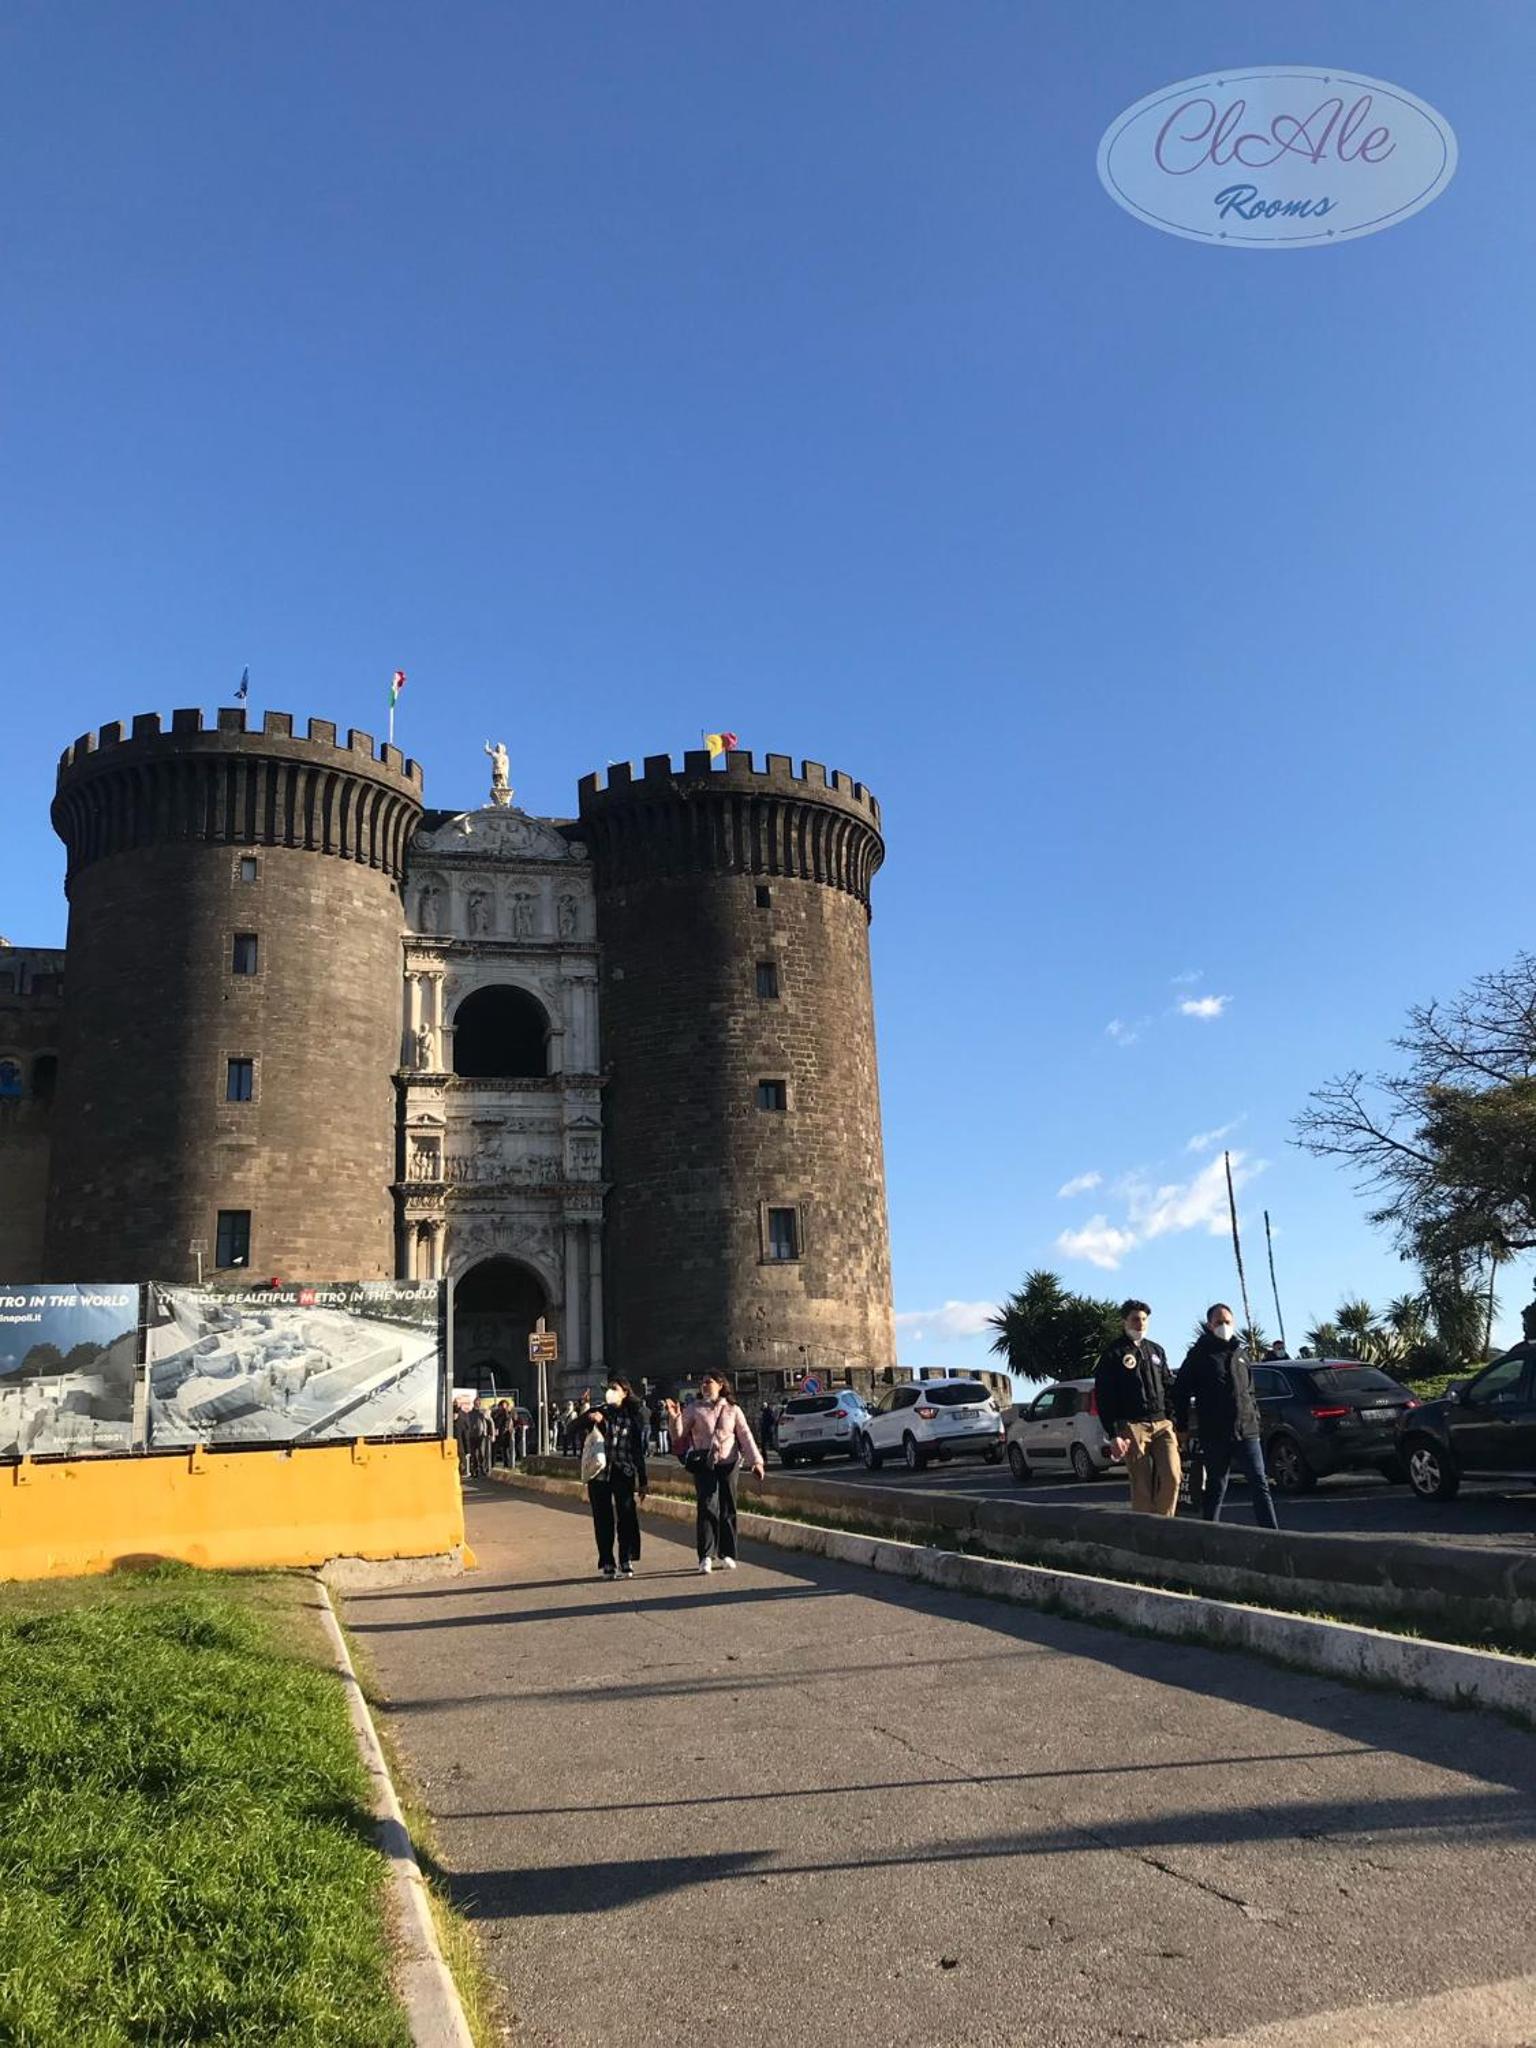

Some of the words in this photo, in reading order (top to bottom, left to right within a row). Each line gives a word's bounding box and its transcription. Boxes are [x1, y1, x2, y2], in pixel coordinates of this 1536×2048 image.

[28, 1296, 46, 1308] IN
[49, 1295, 77, 1308] THE
[80, 1294, 130, 1308] WORLD
[157, 1293, 182, 1304] TH
[227, 1292, 298, 1304] BEAUTIFUL
[299, 1291, 347, 1304] METRO
[349, 1291, 364, 1302] IN
[367, 1290, 394, 1301] THE
[394, 1288, 438, 1300] WORLD
